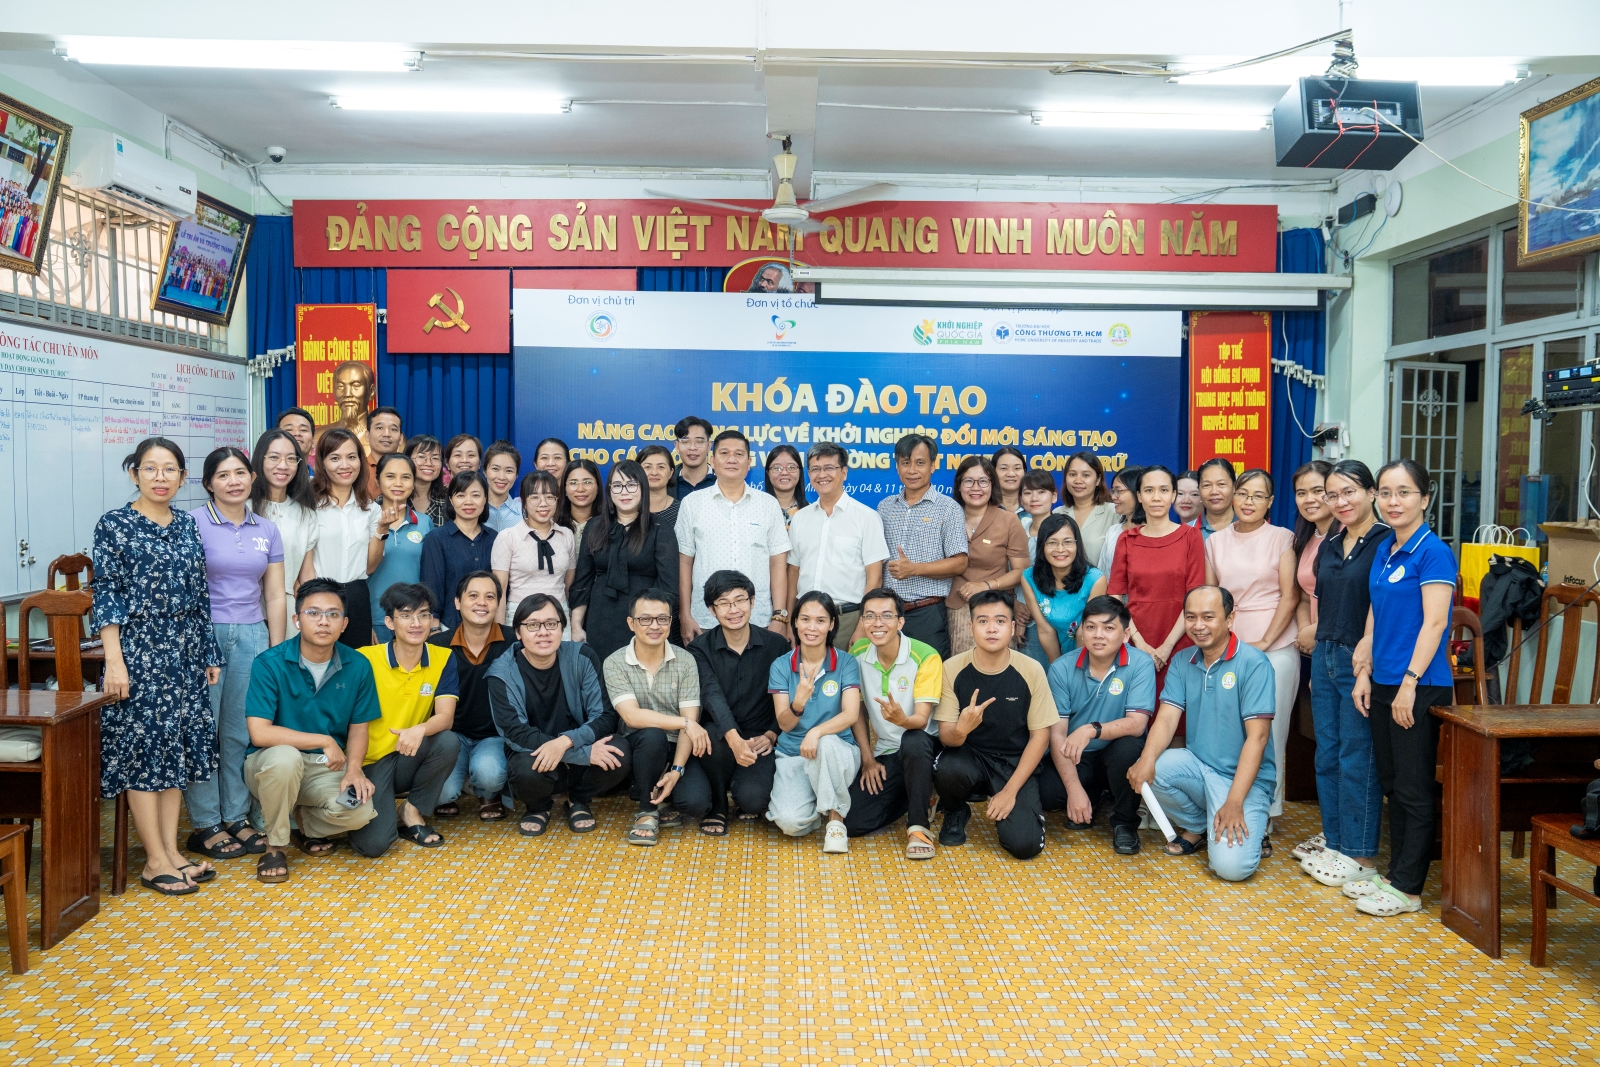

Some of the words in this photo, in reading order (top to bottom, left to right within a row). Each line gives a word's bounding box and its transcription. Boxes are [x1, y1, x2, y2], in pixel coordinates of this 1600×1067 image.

[327, 202, 421, 251] ĐẢNG
[436, 206, 533, 260] CỘNG
[548, 202, 619, 251] SẢN
[632, 207, 711, 260] VIỆT
[726, 215, 804, 251] NAM
[819, 216, 938, 255] QUANG
[951, 217, 1032, 254] VINH
[1046, 210, 1145, 255] MUÔN
[1160, 211, 1238, 256] NĂM
[568, 295, 589, 304] Đơn
[592, 296, 600, 306] vị
[603, 296, 622, 305] chủ
[624, 296, 635, 306] trì
[746, 298, 768, 308] Đơn
[770, 299, 779, 310] vị
[937, 320, 954, 329] KHỞI
[956, 321, 982, 330] NGHIỆP
[937, 330, 965, 338] QUỐC
[23, 335, 41, 352] TÁC
[43, 341, 78, 358] CHUYÊN
[80, 346, 98, 360] MÔN
[303, 334, 326, 361] ĐẢNG
[327, 336, 350, 366] CỘNG
[352, 334, 370, 361] SẢN
[1219, 342, 1230, 364] TẬP
[1231, 339, 1243, 360] THỂ
[176, 363, 191, 376] LỊCH
[192, 364, 208, 376] CÔNG
[210, 367, 220, 378] TÁC
[1201, 366, 1212, 388] HỘI
[1213, 364, 1230, 384] ĐỒNG
[1232, 367, 1241, 384] SƯ
[1242, 368, 1260, 386] PHẠM
[316, 369, 334, 398] VIỆT
[711, 377, 819, 414] KHÓA
[825, 378, 908, 415] ĐÀO
[914, 385, 988, 423] TẠO
[1196, 392, 1216, 408] TRUNG
[1217, 392, 1230, 410] HỌC
[1231, 386, 1244, 407] PHỔ
[1245, 389, 1266, 406] THÔNG
[1202, 411, 1227, 430] NGUYỄN
[1228, 412, 1246, 430] CÔNG
[1247, 412, 1260, 430] TRỨ
[578, 420, 634, 440] NÂNG
[638, 424, 677, 441] CAO
[743, 423, 782, 446] LỰC
[784, 422, 810, 442] VỀ
[813, 422, 862, 444] KHỞI
[941, 423, 976, 444] ĐỔI
[980, 426, 1020, 446] MỚI
[1023, 427, 1076, 446] SÁNG
[1079, 430, 1118, 451] TẠO
[1215, 436, 1232, 454] ĐOÀN
[569, 448, 610, 464] CHO
[612, 446, 641, 462] CÁ
[848, 449, 890, 469] ỜNG
[1030, 452, 1070, 472] CÔN
[1098, 453, 1128, 472] RỨ
[860, 484, 872, 493] 04
[874, 484, 882, 493] &
[885, 484, 896, 493] 11
[1564, 574, 1586, 586] InFocus
